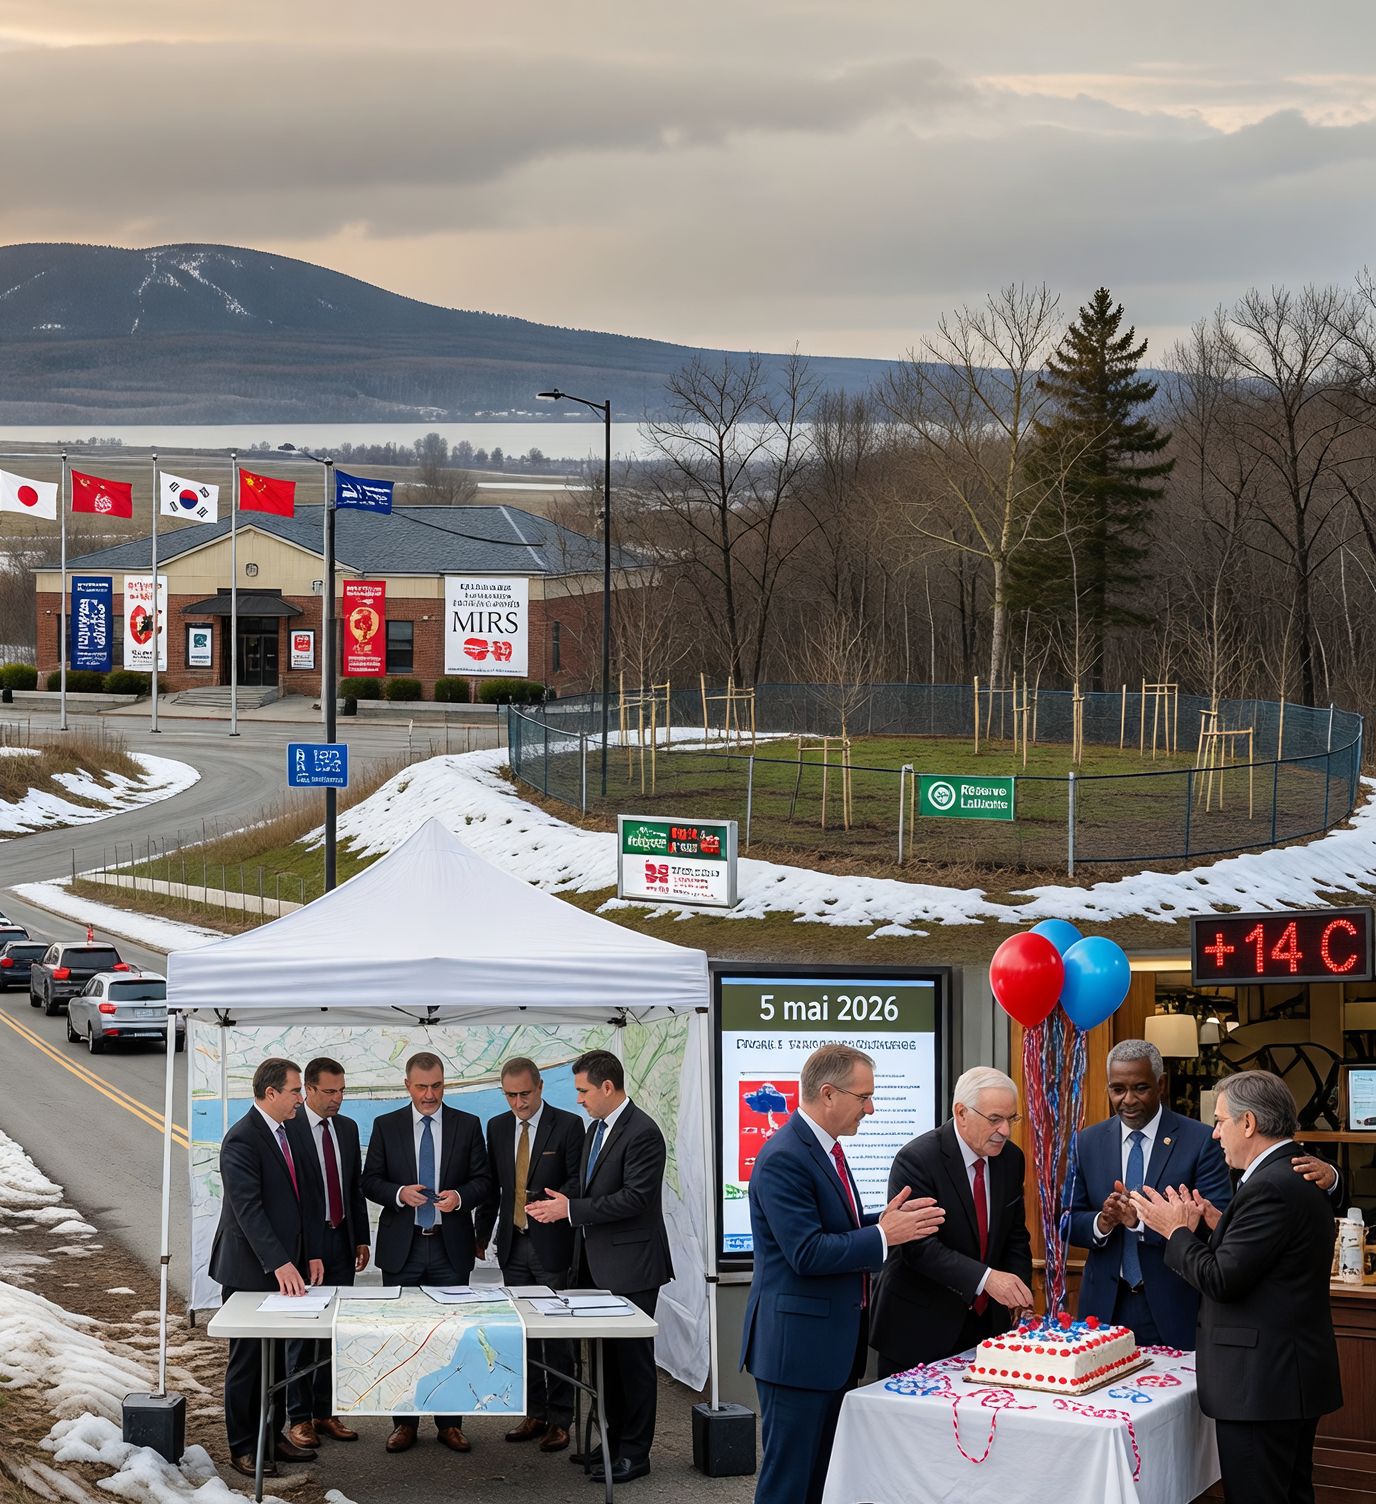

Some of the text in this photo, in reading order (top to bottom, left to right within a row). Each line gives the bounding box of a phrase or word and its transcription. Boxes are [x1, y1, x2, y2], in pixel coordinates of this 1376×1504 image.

[452, 611, 519, 634] MIRS
[1204, 918, 1358, 974] +14 C
[759, 994, 899, 1022] 5 mai 2026
